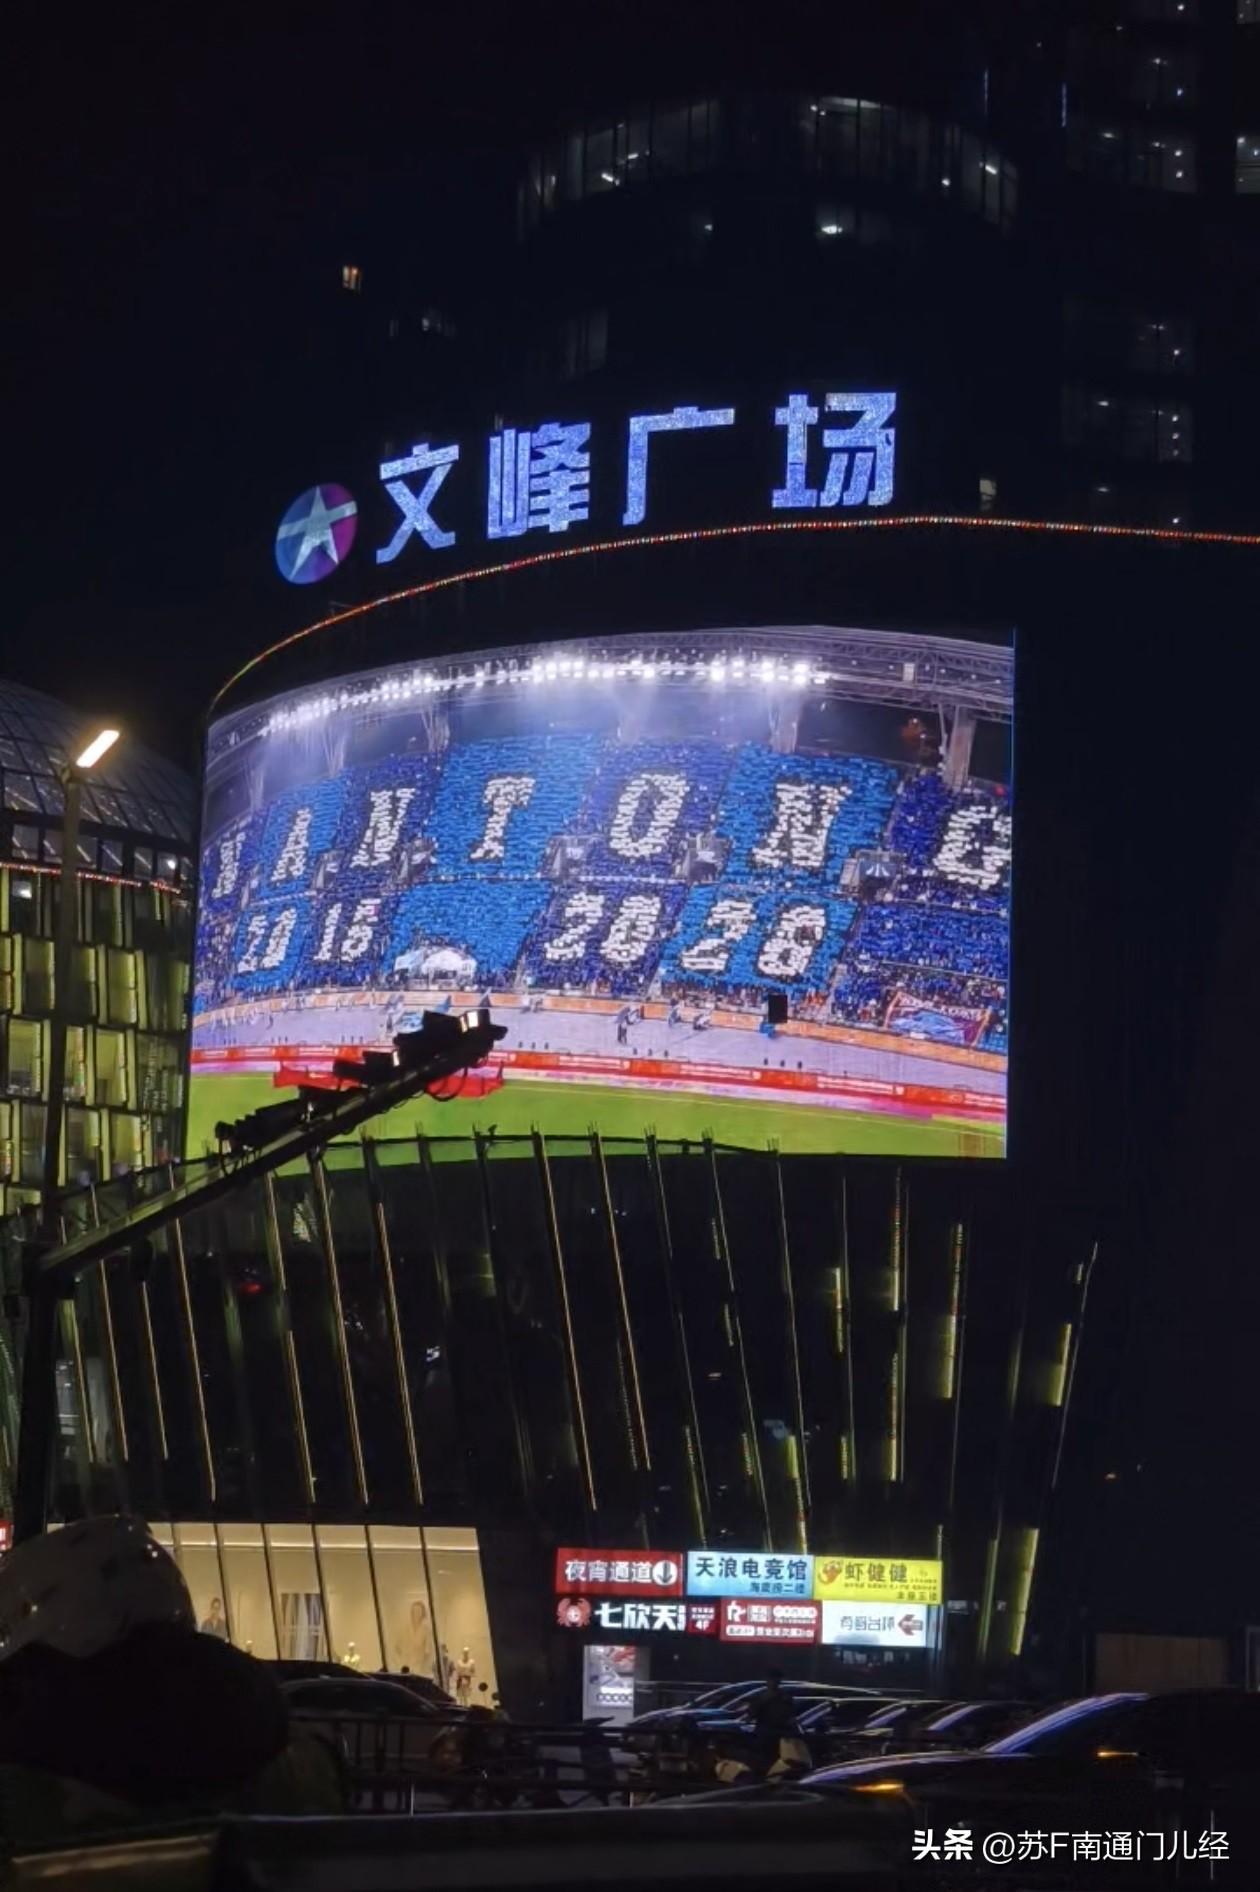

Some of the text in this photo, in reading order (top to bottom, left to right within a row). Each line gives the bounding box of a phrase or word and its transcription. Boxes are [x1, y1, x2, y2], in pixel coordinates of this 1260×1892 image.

[376, 392, 896, 564] 文峰广场
[564, 1559, 653, 1583] 夜宵通道
[696, 1556, 807, 1581] 天浪电竞馆
[844, 1561, 908, 1583] 虾健健
[594, 1602, 678, 1631] 七欣天
